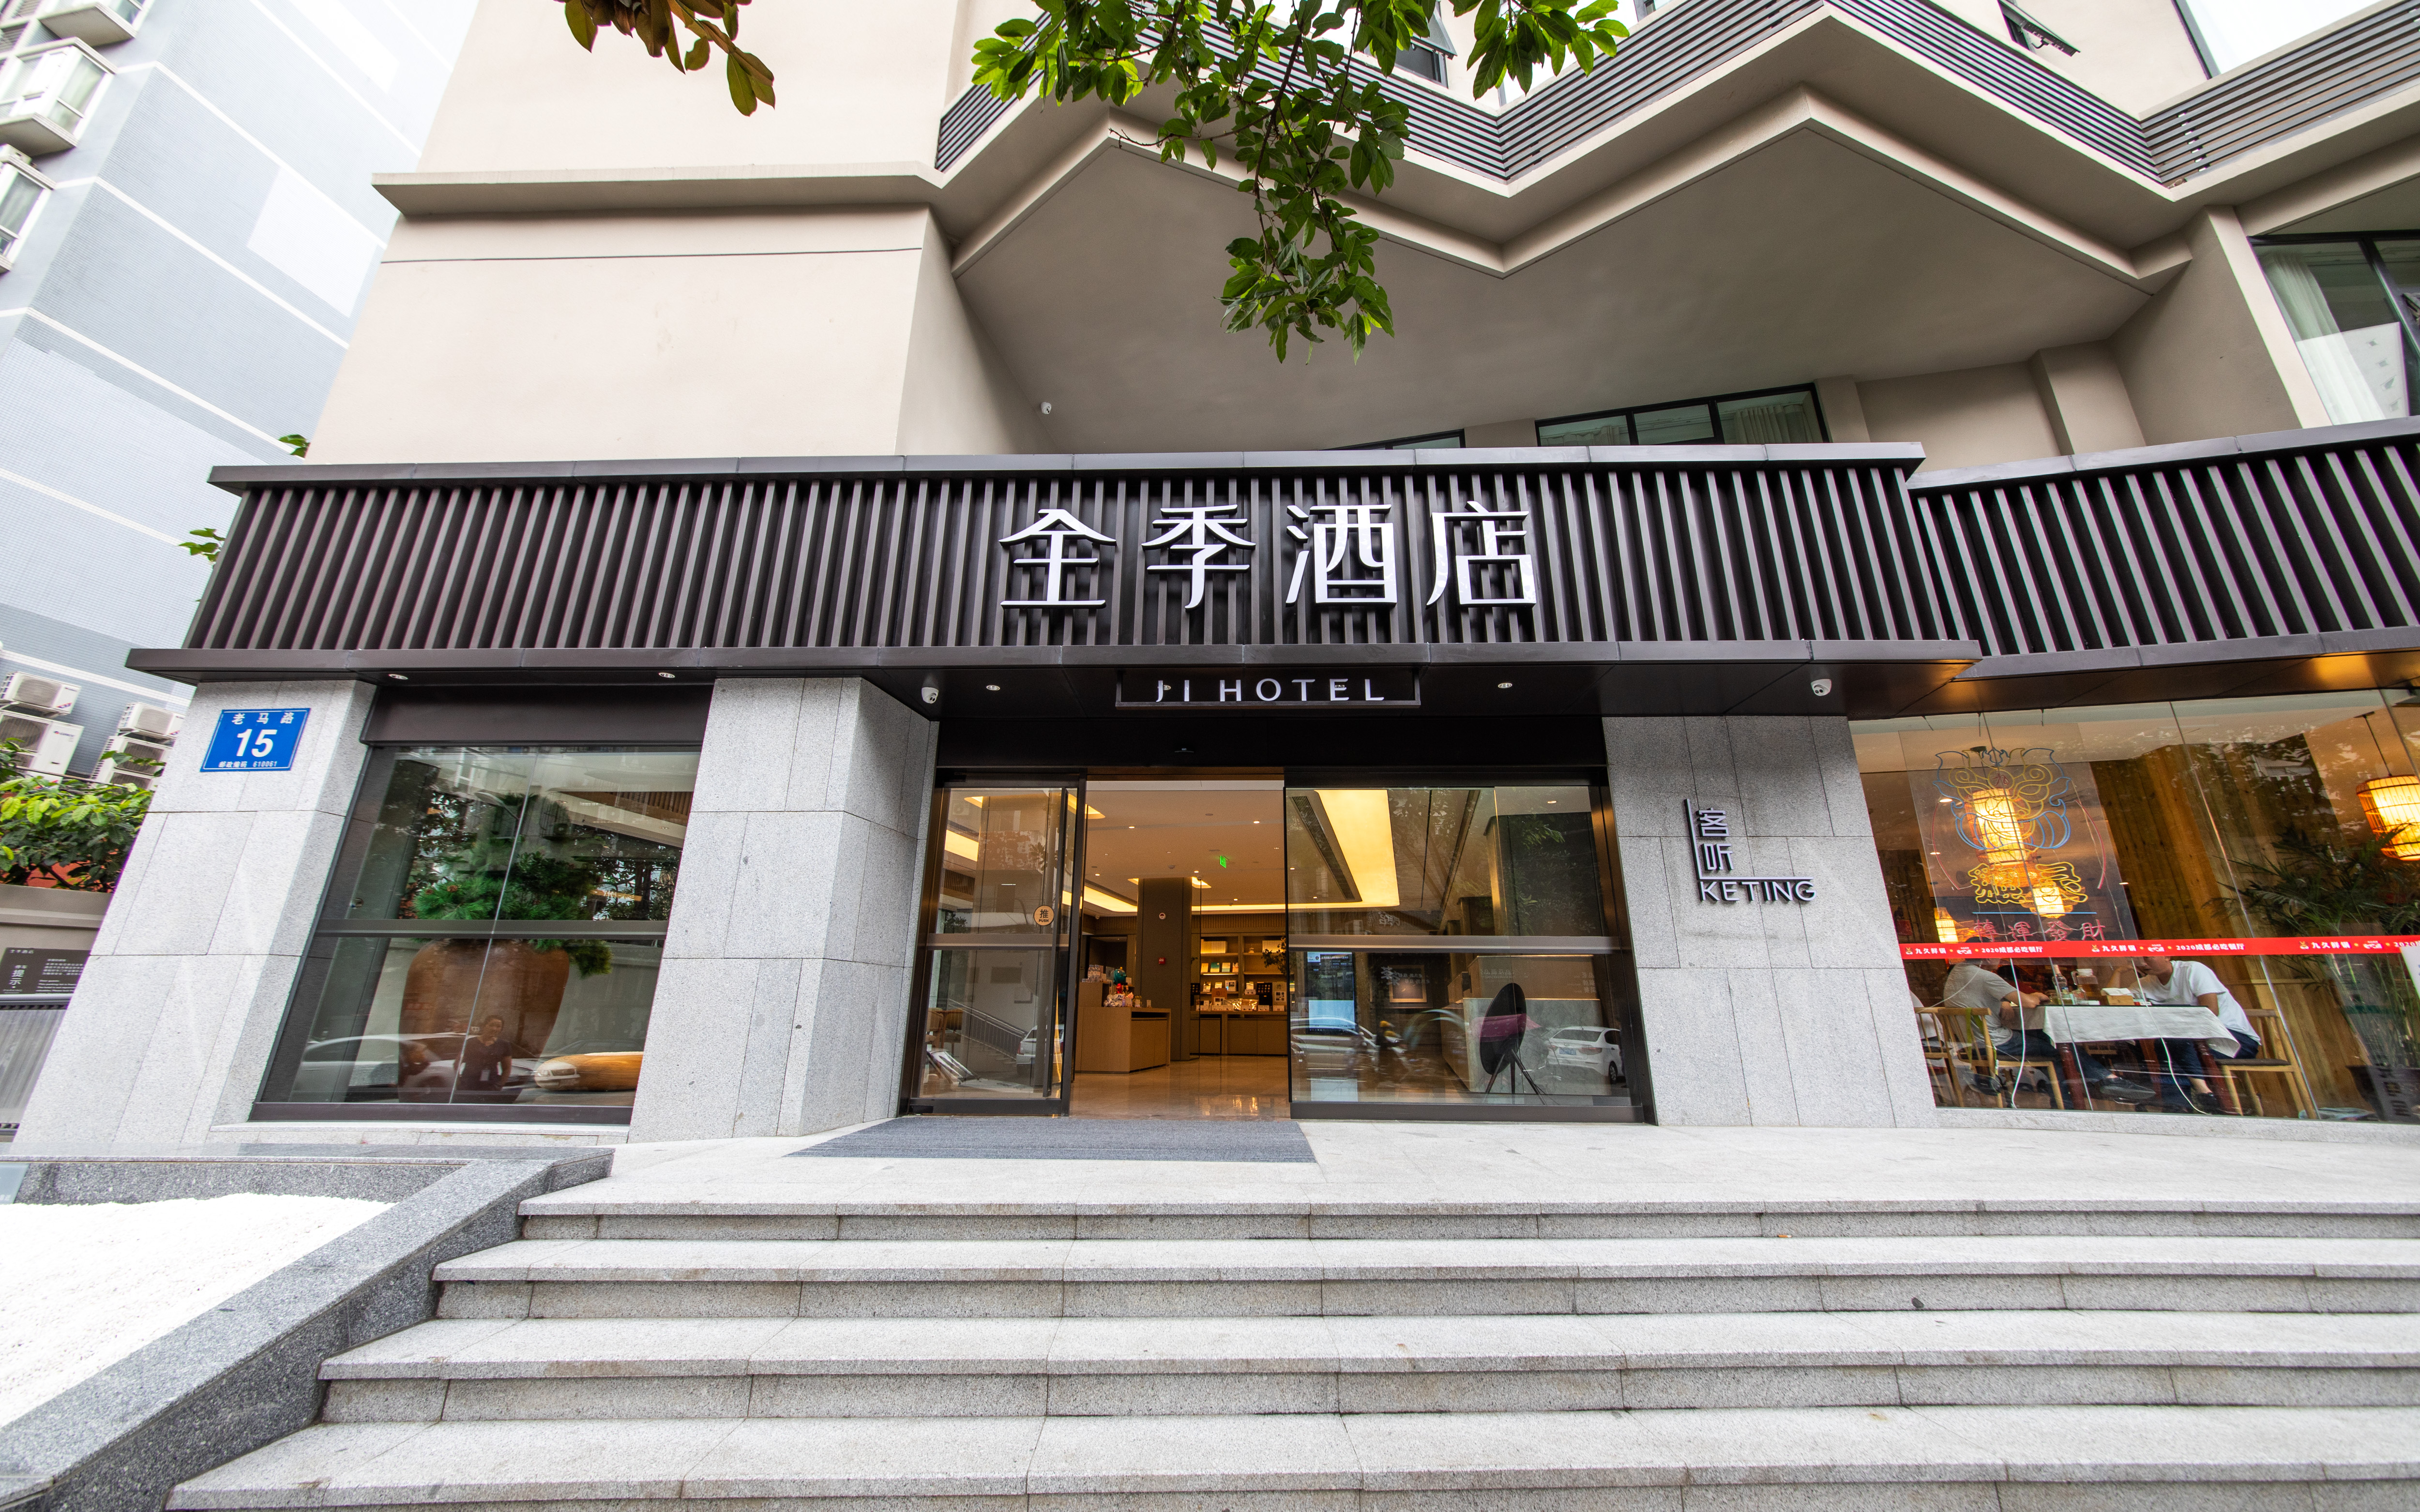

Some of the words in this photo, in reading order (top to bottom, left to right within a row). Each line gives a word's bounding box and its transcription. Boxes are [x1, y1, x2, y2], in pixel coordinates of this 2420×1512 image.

[998, 501, 1537, 610] 全季酒店
[1155, 680, 1190, 702] JI
[1219, 678, 1385, 702] HOTEL
[231, 712, 294, 725] 老马路
[236, 728, 278, 758] 15
[1698, 881, 1817, 901] KETING
[1039, 909, 1049, 918] 推
